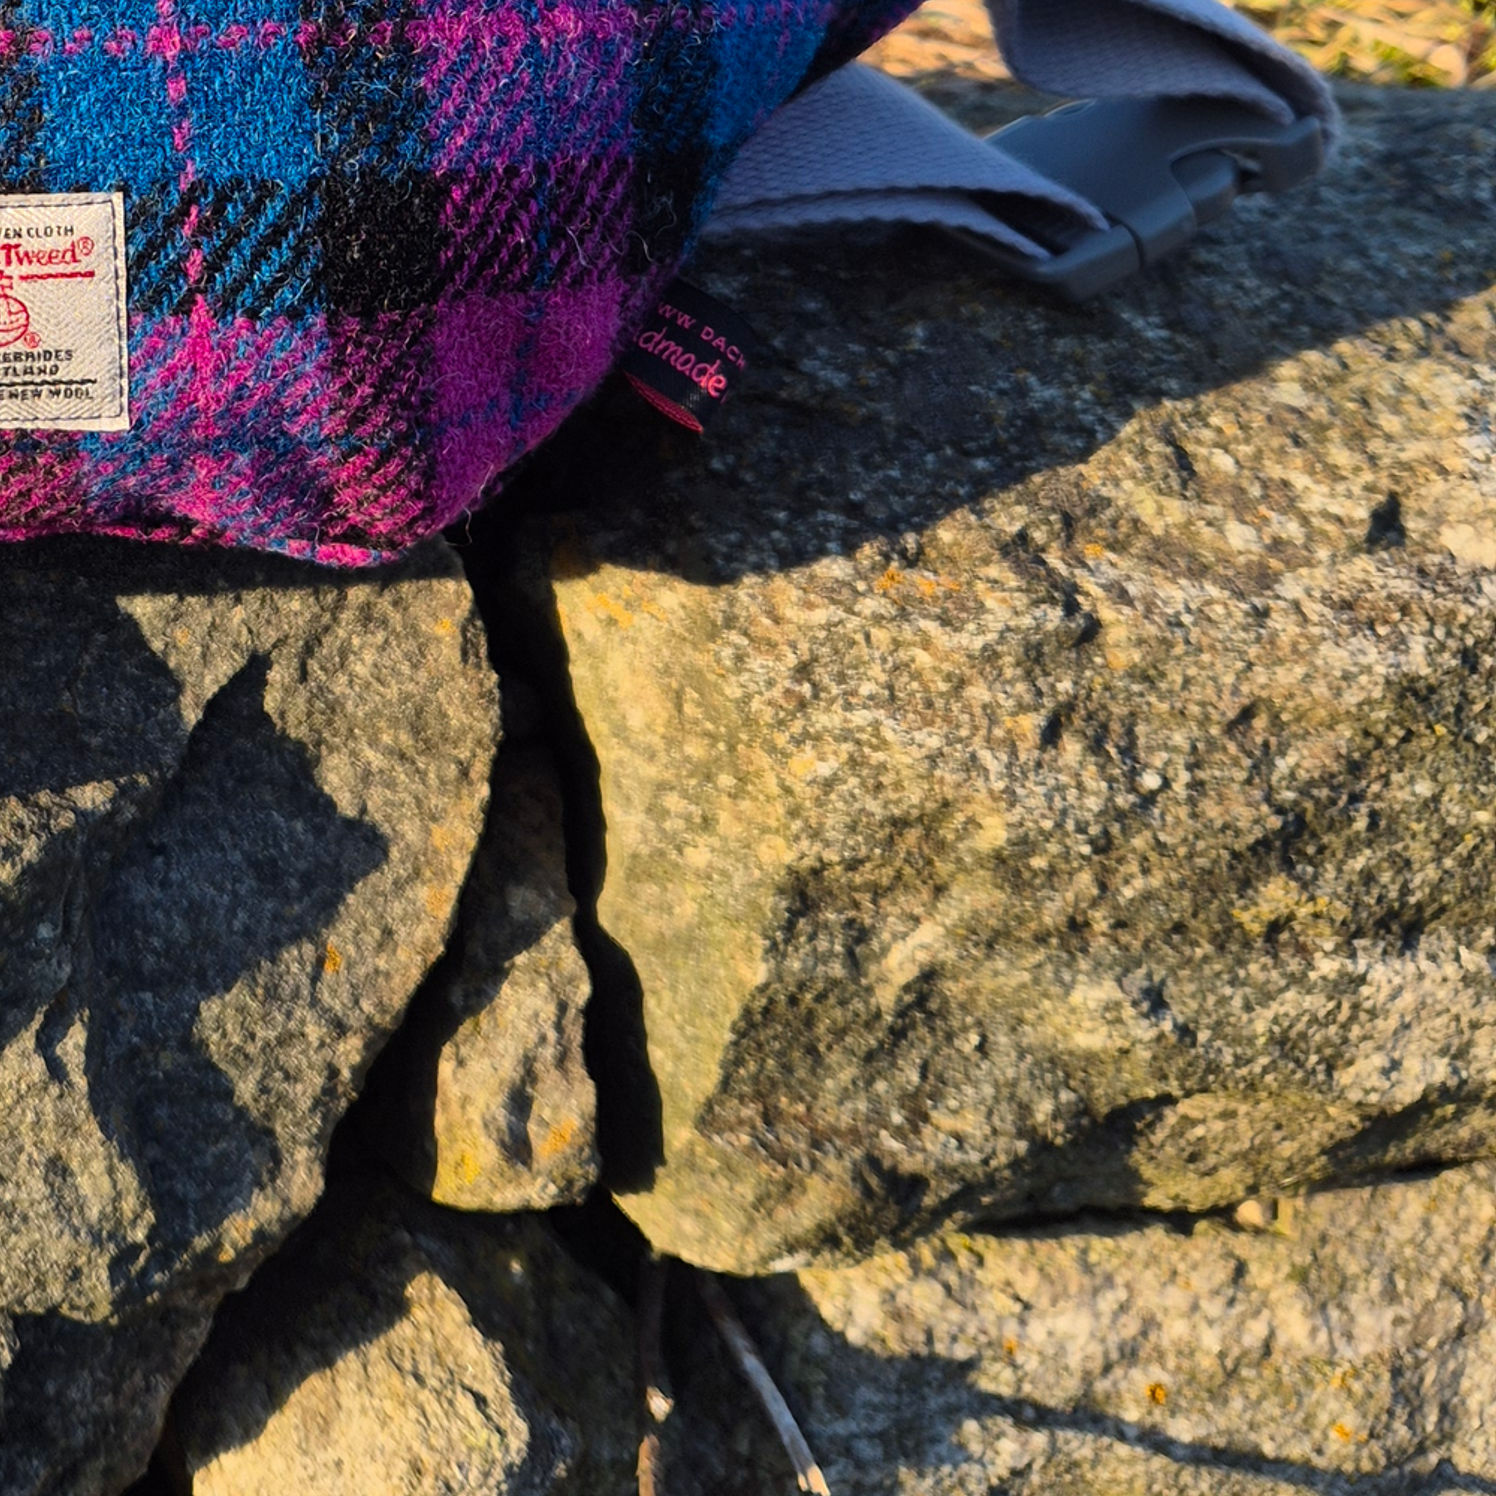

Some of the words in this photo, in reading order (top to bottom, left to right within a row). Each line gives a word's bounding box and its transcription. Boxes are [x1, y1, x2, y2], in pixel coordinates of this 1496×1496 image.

[26, 225, 74, 238] CLOTH
[633, 327, 727, 397] dmade
[8, 389, 42, 401] NEW
[48, 387, 93, 399] WOOL
